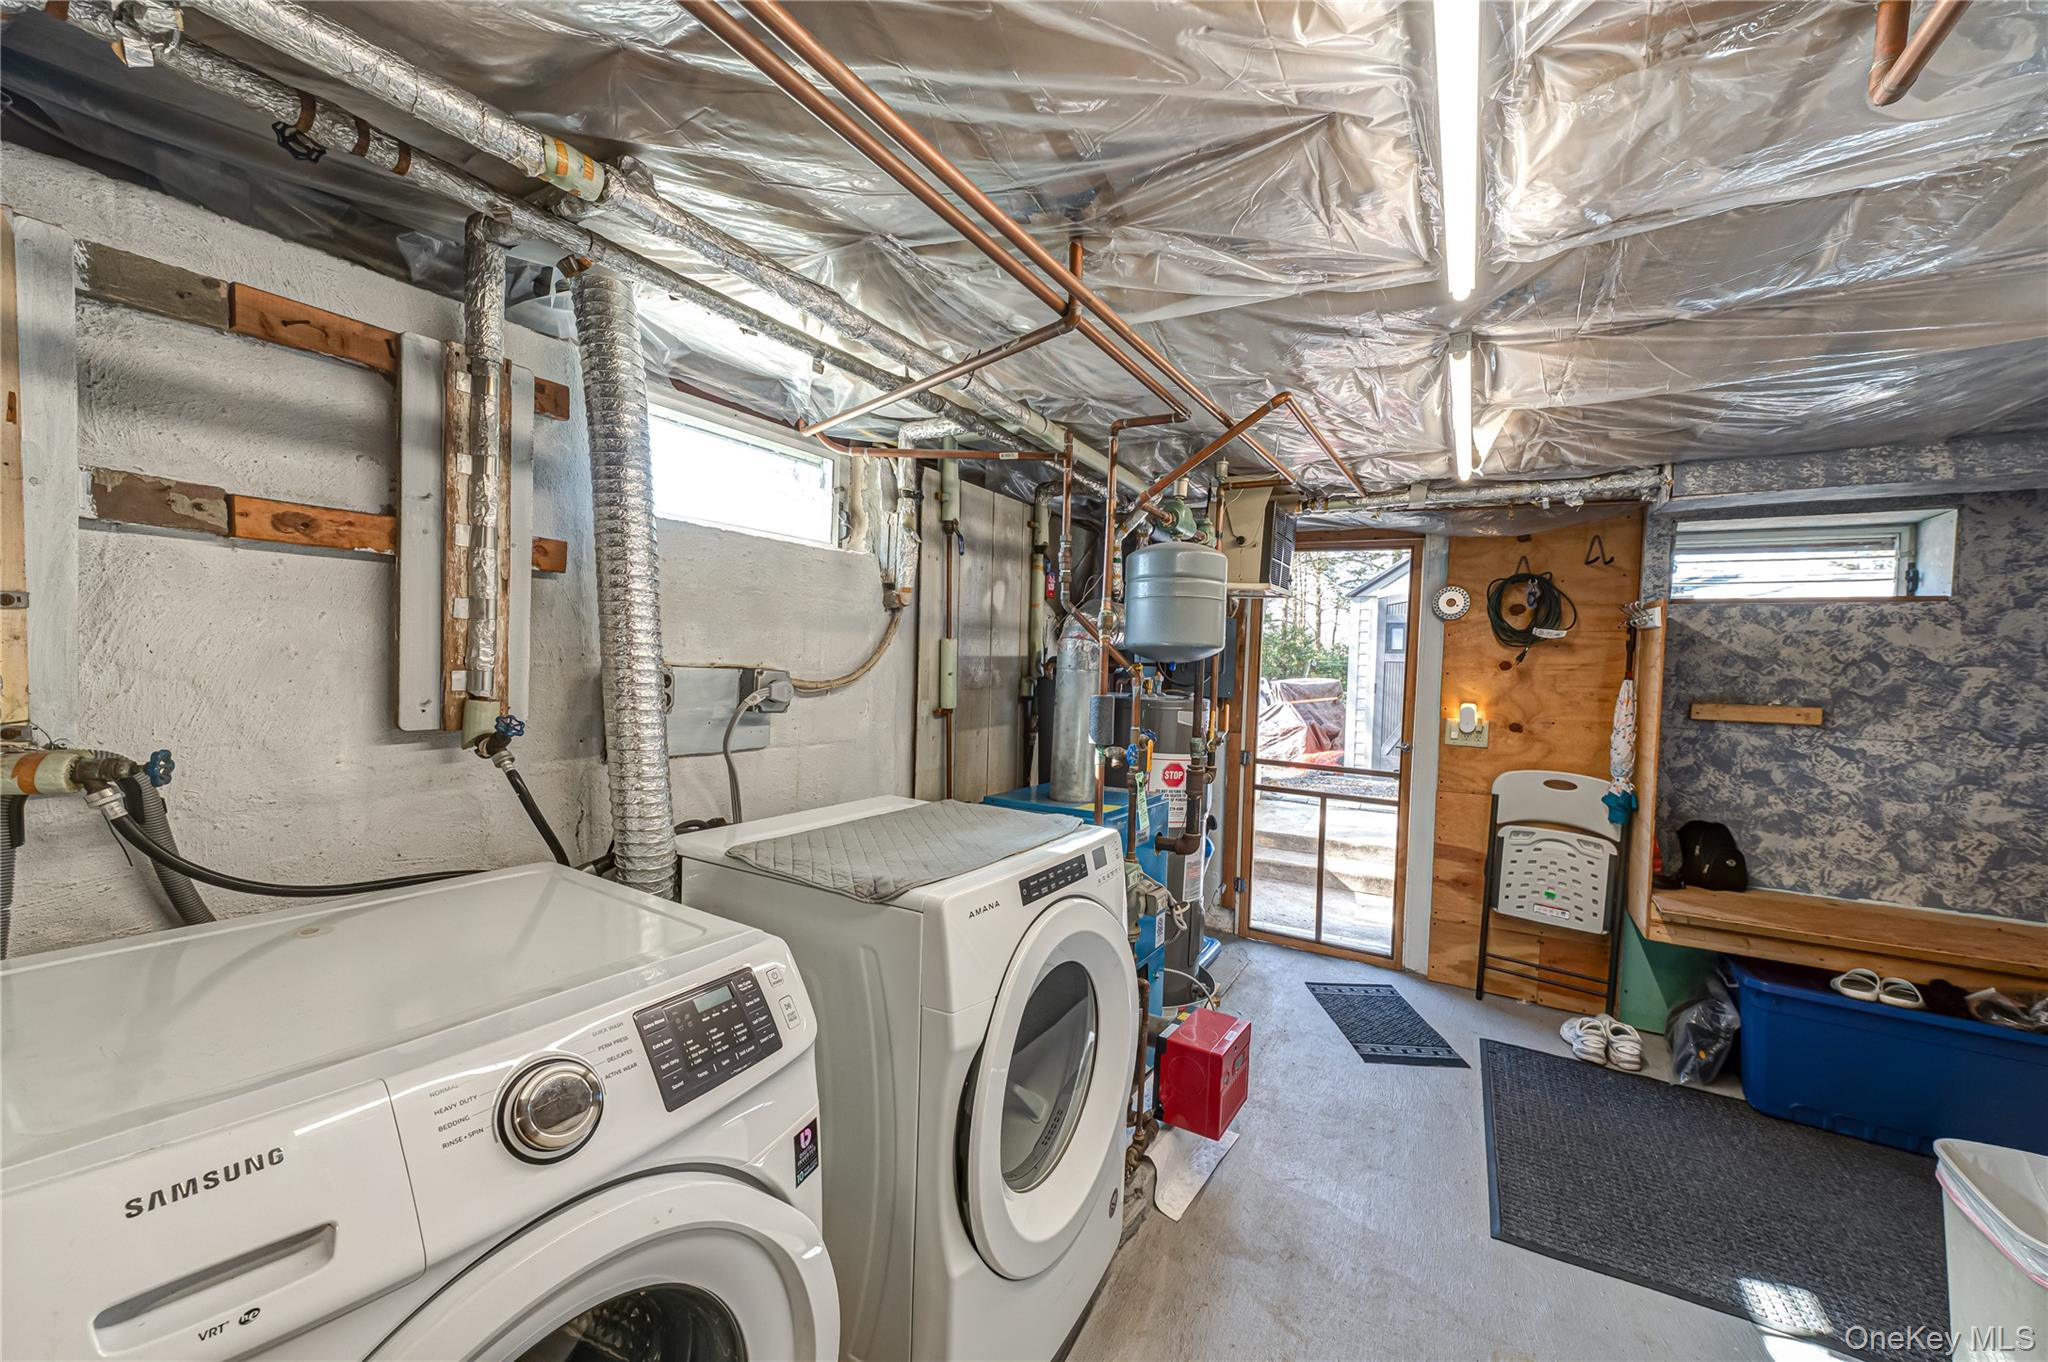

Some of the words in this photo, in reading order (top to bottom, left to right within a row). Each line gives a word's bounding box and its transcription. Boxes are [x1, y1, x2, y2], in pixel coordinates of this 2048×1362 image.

[1164, 770, 1184, 780] STOP
[969, 900, 1000, 919] AMANA
[607, 1048, 633, 1063] DELICATES
[605, 1068, 622, 1080] ACTIVE
[623, 1062, 638, 1072] WEAR
[433, 1102, 458, 1116] HEAVY
[459, 1094, 478, 1106] DUTY
[438, 1114, 471, 1133] BEDDING
[124, 1147, 285, 1219] SAMSUNG
